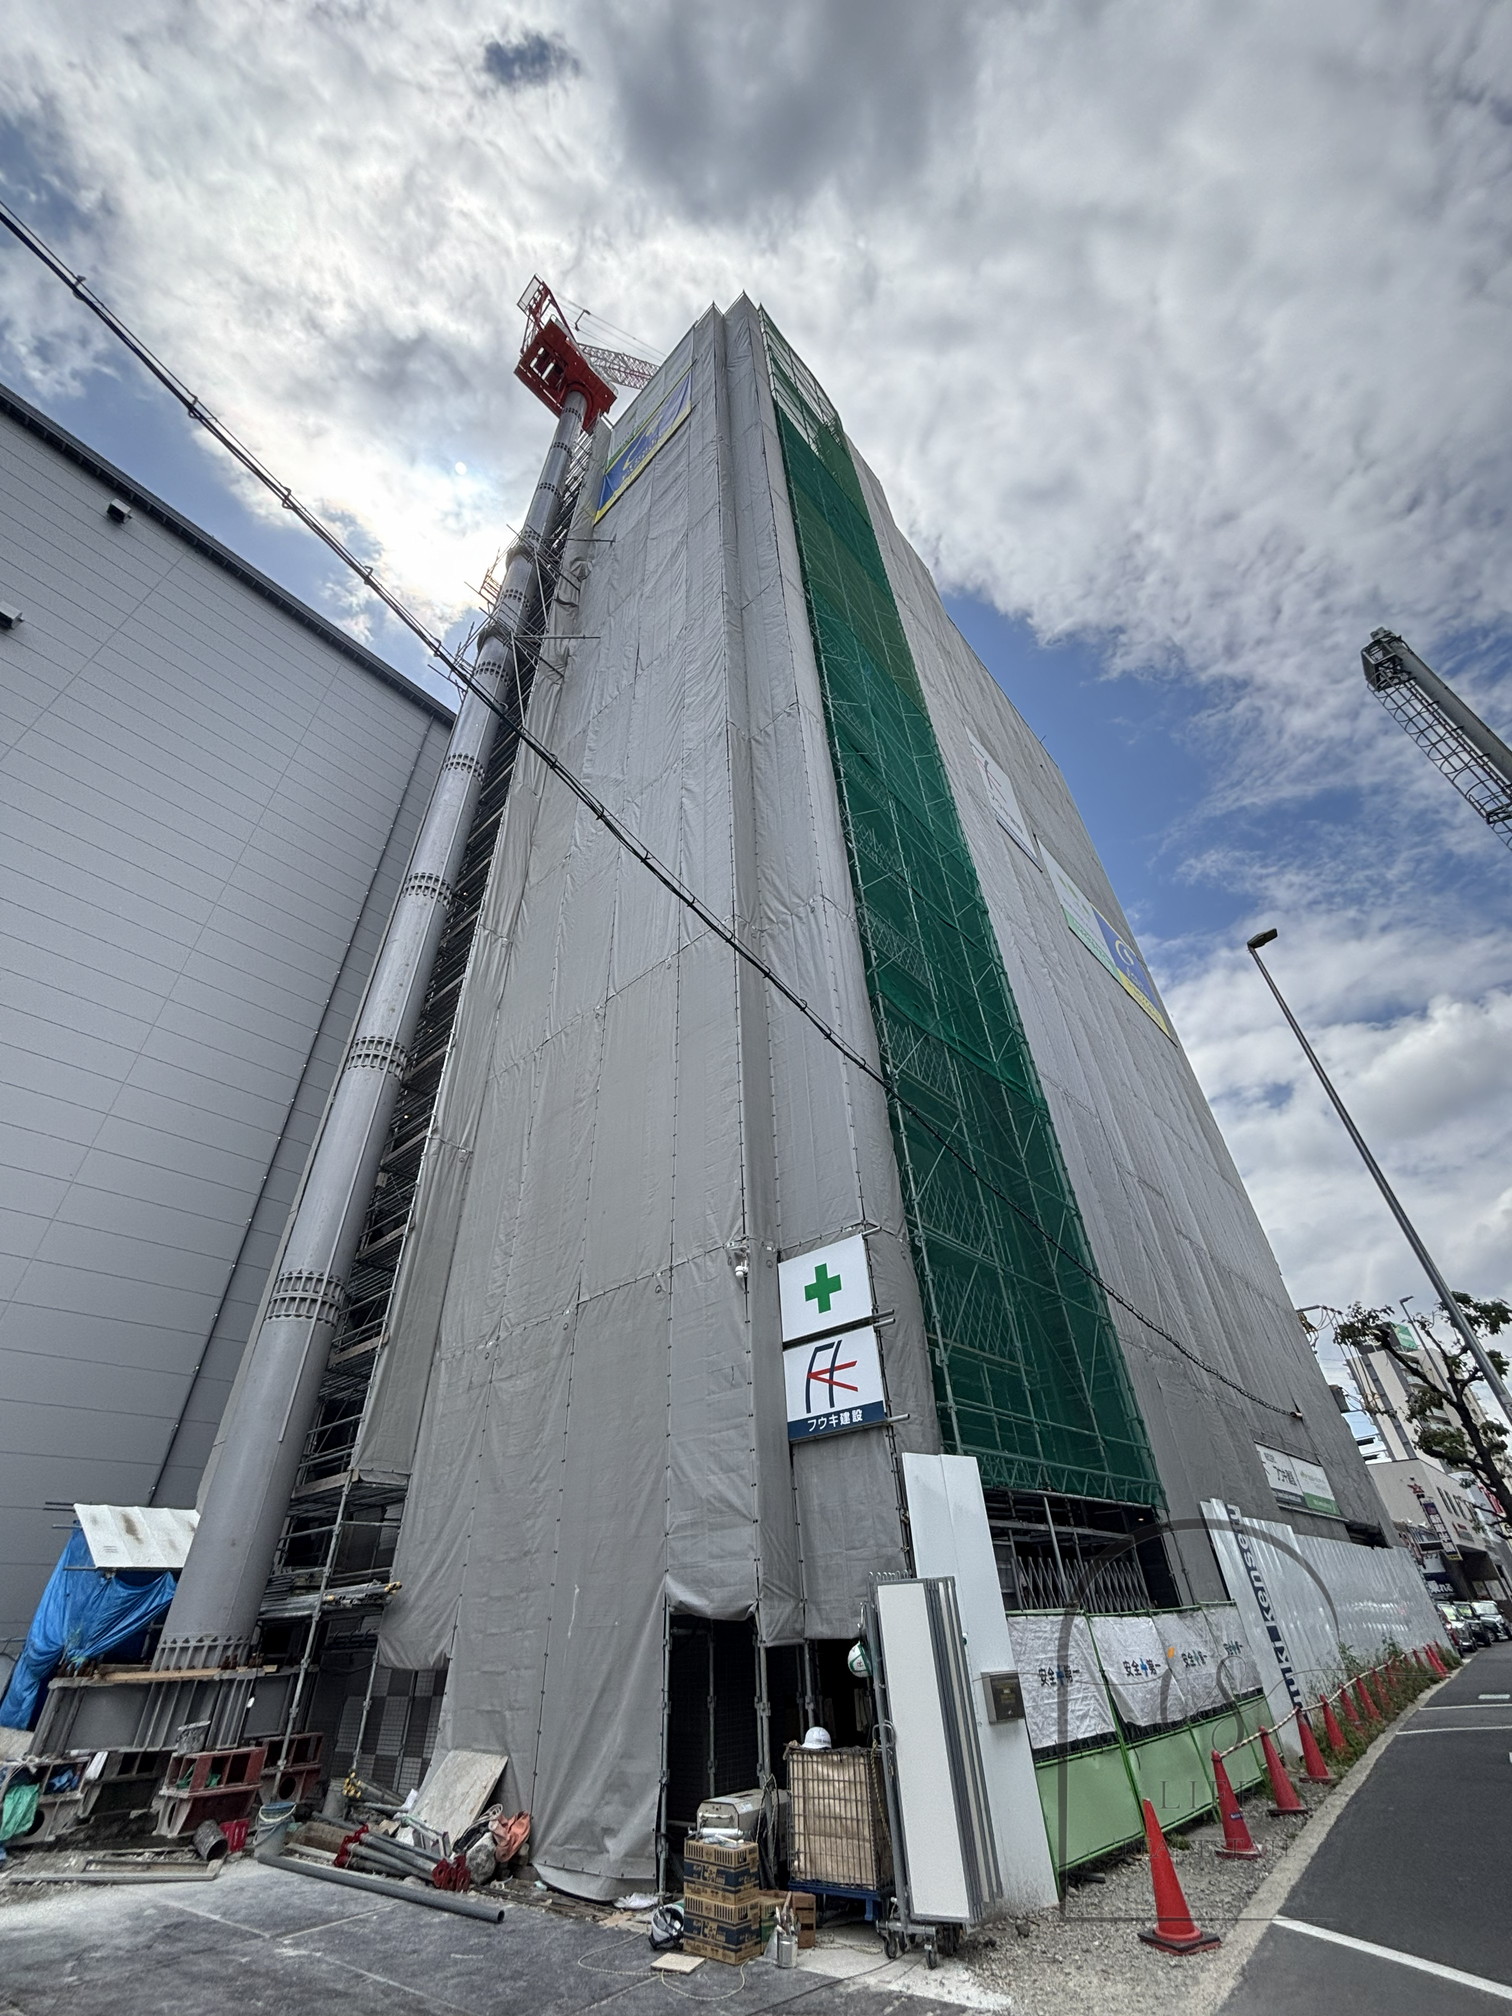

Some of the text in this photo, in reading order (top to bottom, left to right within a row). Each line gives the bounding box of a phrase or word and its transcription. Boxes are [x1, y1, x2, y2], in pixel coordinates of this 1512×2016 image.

[807, 1408, 864, 1432] フウキ建設
